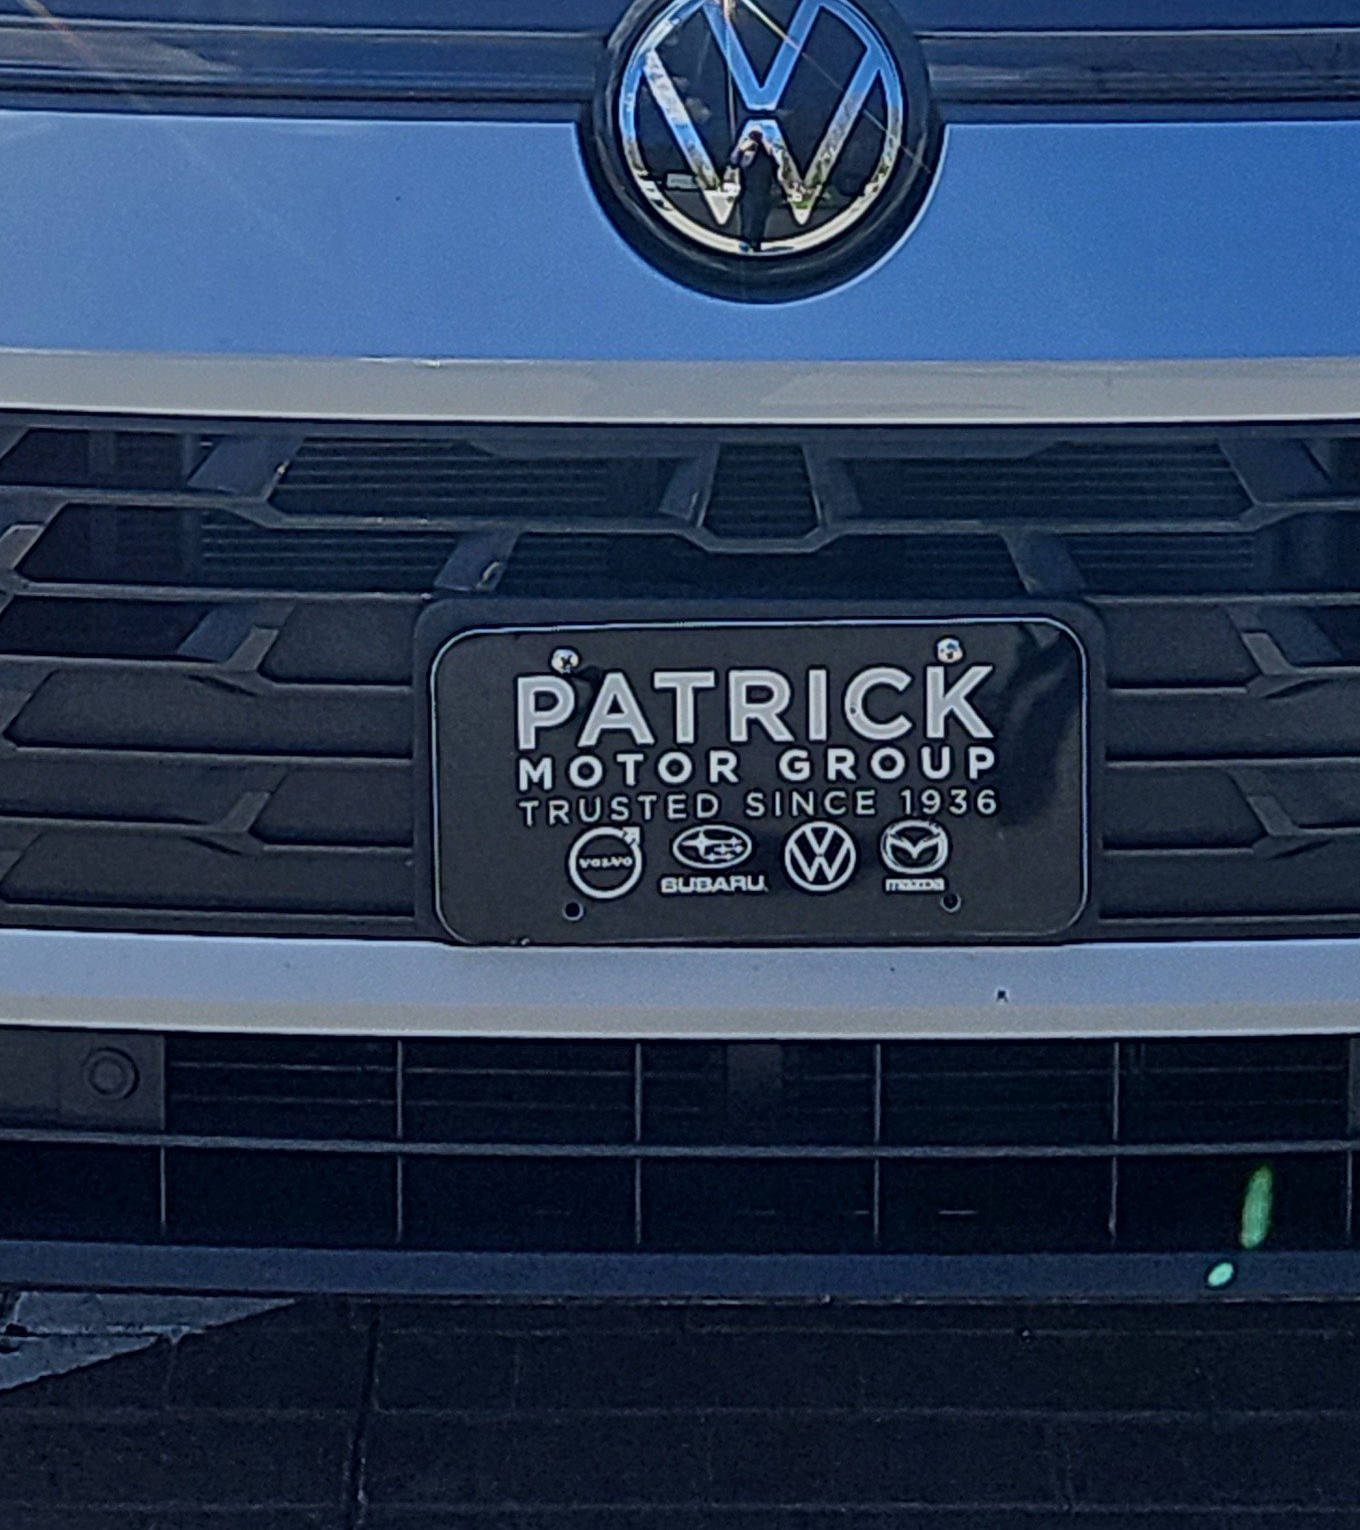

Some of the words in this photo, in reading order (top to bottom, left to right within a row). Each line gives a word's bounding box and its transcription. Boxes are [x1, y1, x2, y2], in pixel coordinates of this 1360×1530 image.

[516, 666, 994, 750] PATRICK
[517, 750, 740, 792] MOTOR
[778, 747, 997, 782] GROUP
[519, 792, 721, 826] TRUSTED
[745, 789, 877, 817] SINCE
[899, 788, 998, 816] 1936
[660, 875, 764, 894] SUBARU
